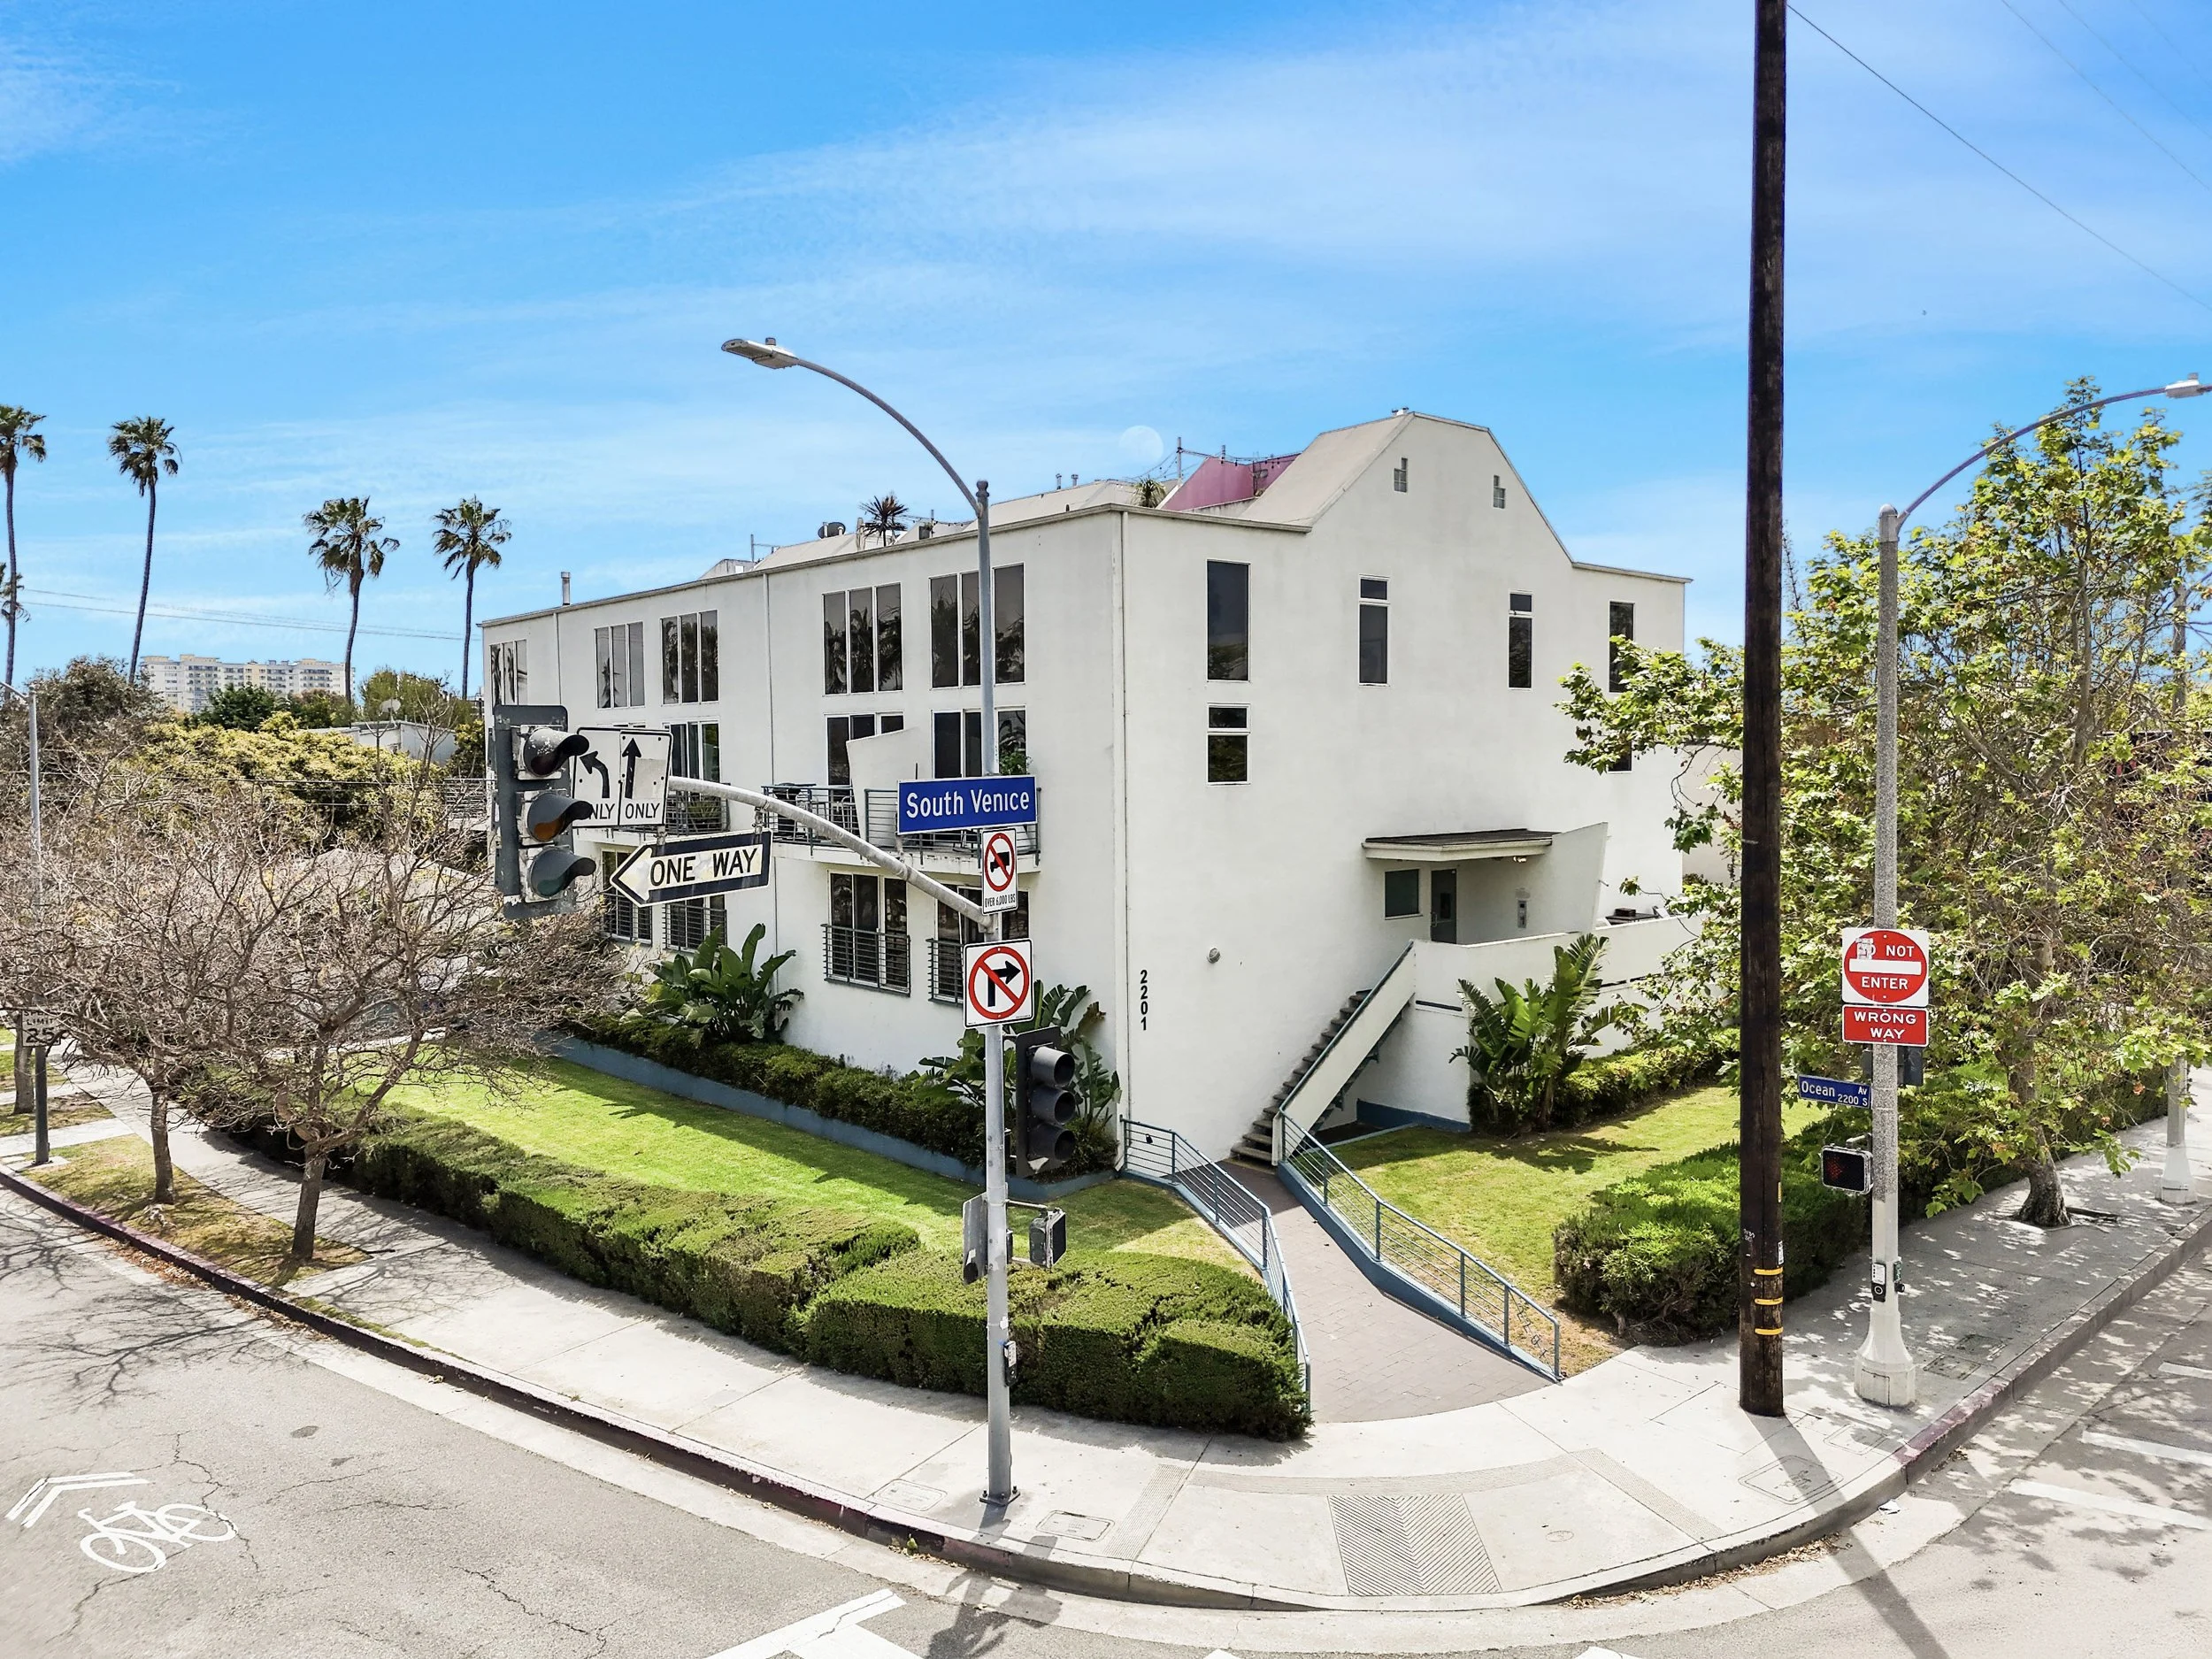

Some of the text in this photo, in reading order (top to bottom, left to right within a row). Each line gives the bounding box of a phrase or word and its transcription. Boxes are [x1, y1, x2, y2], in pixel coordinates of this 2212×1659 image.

[906, 788, 1030, 818] South Venice
[589, 803, 615, 819] NLY
[625, 803, 660, 819] ONLY
[650, 848, 757, 887] ONE WAY
[985, 897, 995, 908] OVER
[1886, 945, 1915, 957] NOT
[1862, 976, 1908, 990] ENTER
[1854, 1010, 1916, 1025] WRONG
[26, 1027, 54, 1043] 25
[1870, 1027, 1905, 1040] WAY
[1801, 1080, 1867, 1097] Ocean Av
[1838, 1094, 1868, 1107] 2200 S
